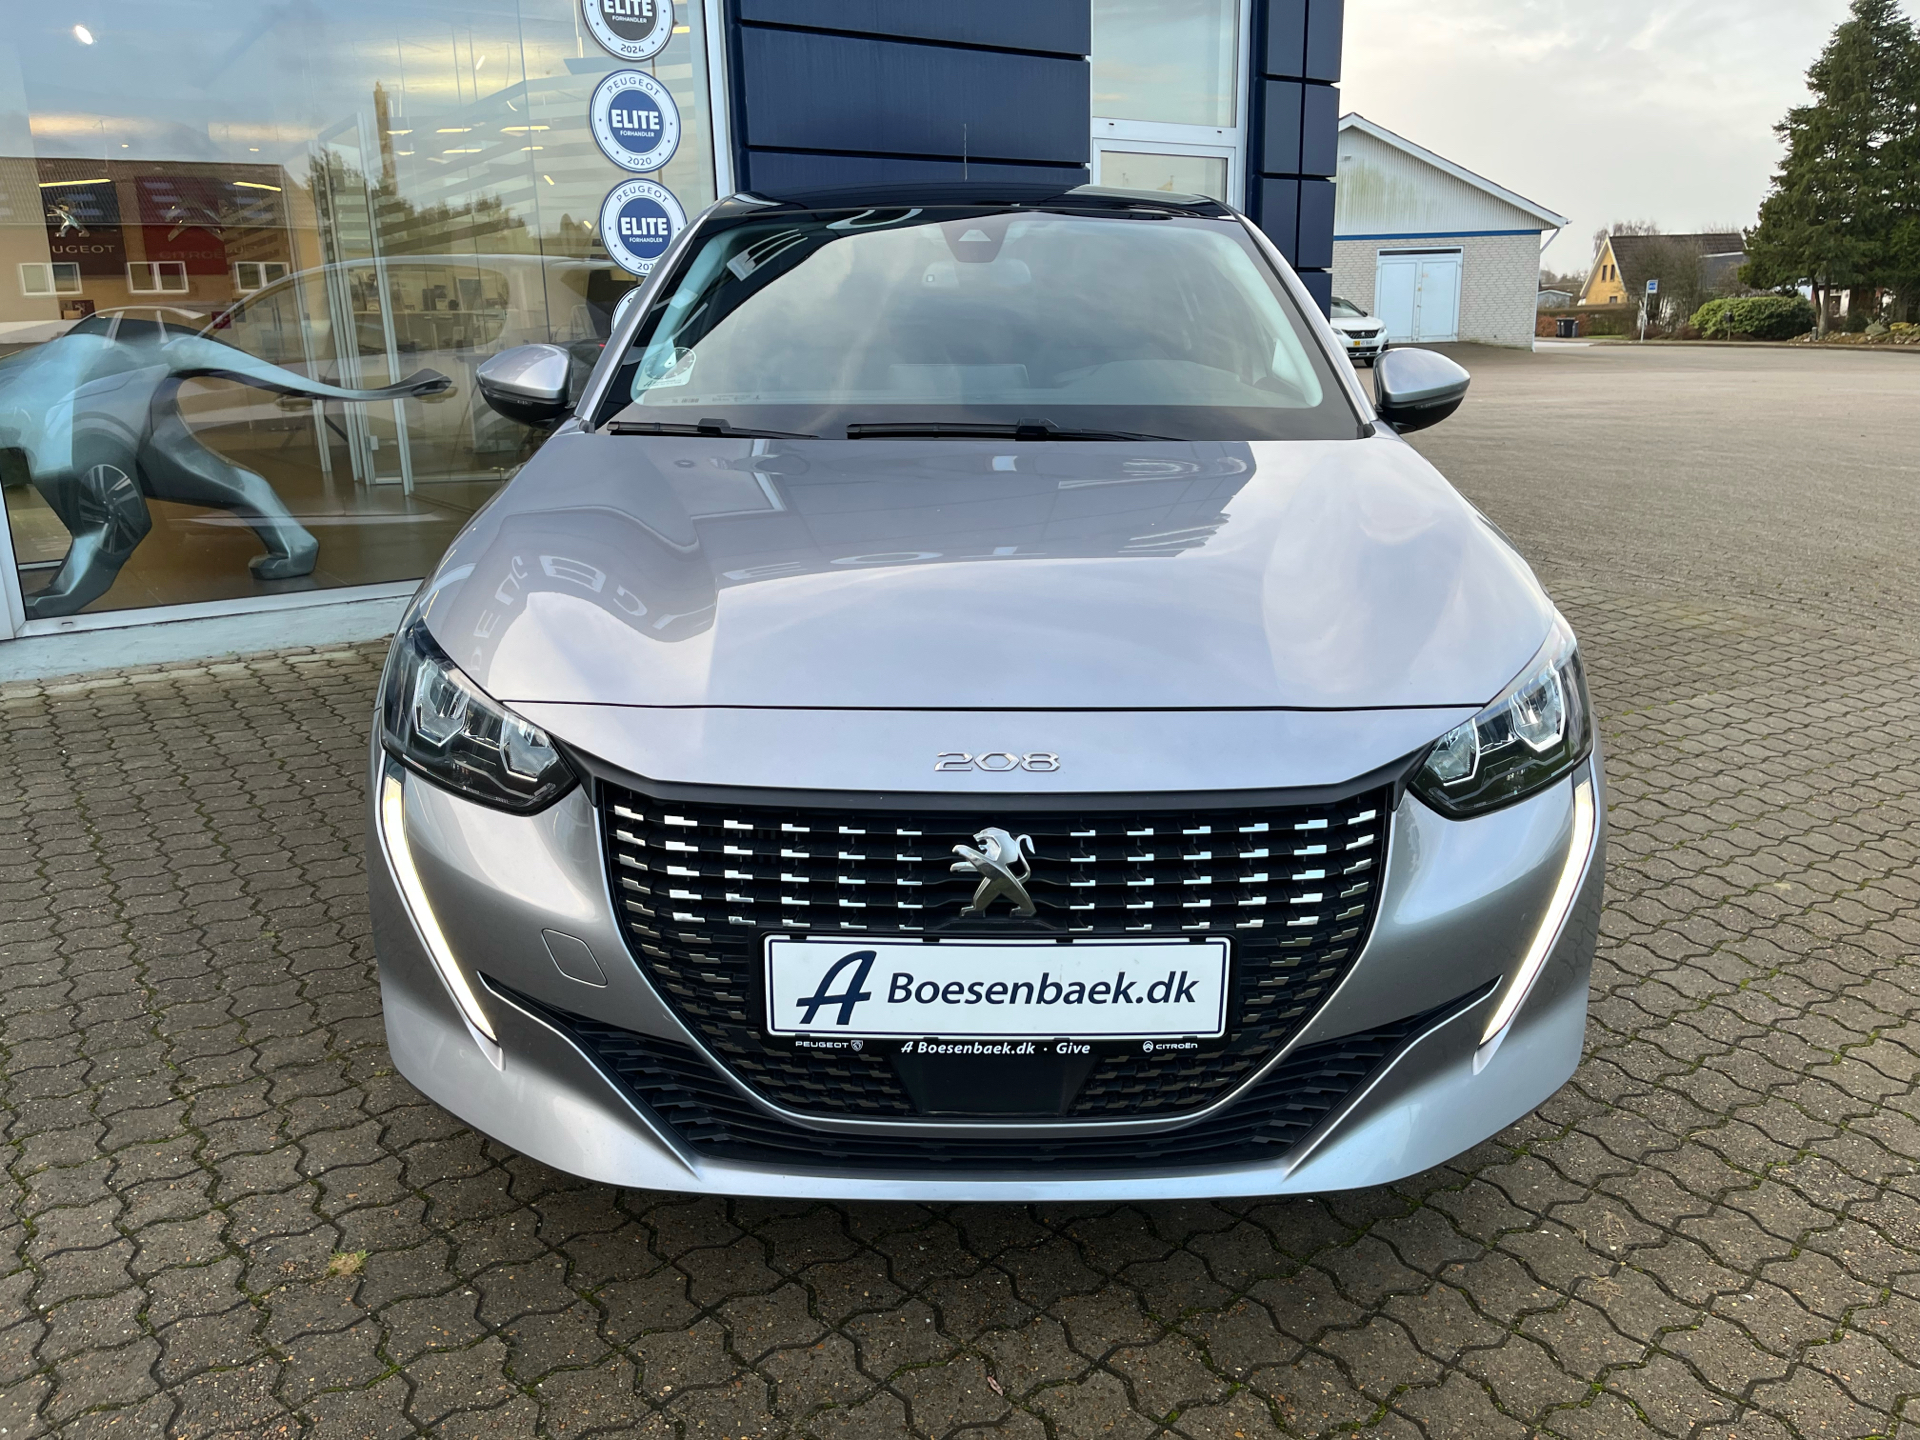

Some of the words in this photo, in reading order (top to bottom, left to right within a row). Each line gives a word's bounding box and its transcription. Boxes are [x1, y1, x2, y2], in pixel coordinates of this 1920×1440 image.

[603, 0, 653, 17] ELITE
[612, 15, 648, 24] FORHANDLER
[620, 43, 645, 54] 2024
[606, 76, 661, 97] PEUGEOT
[611, 109, 660, 130] ELITE
[620, 129, 655, 138] FORHANDLER
[627, 156, 652, 167] 2020
[616, 185, 669, 204] PEUGEOT
[620, 216, 668, 236] ELITE
[629, 236, 663, 244] FORHANDLER
[637, 262, 656, 271] 202
[934, 752, 1060, 772] 208
[887, 970, 1200, 1006] Boesenbaek.dk
[795, 1040, 849, 1048] PEUGEOT
[917, 1041, 1036, 1055] Boesenbaek.dk
[1056, 1042, 1091, 1054] Give
